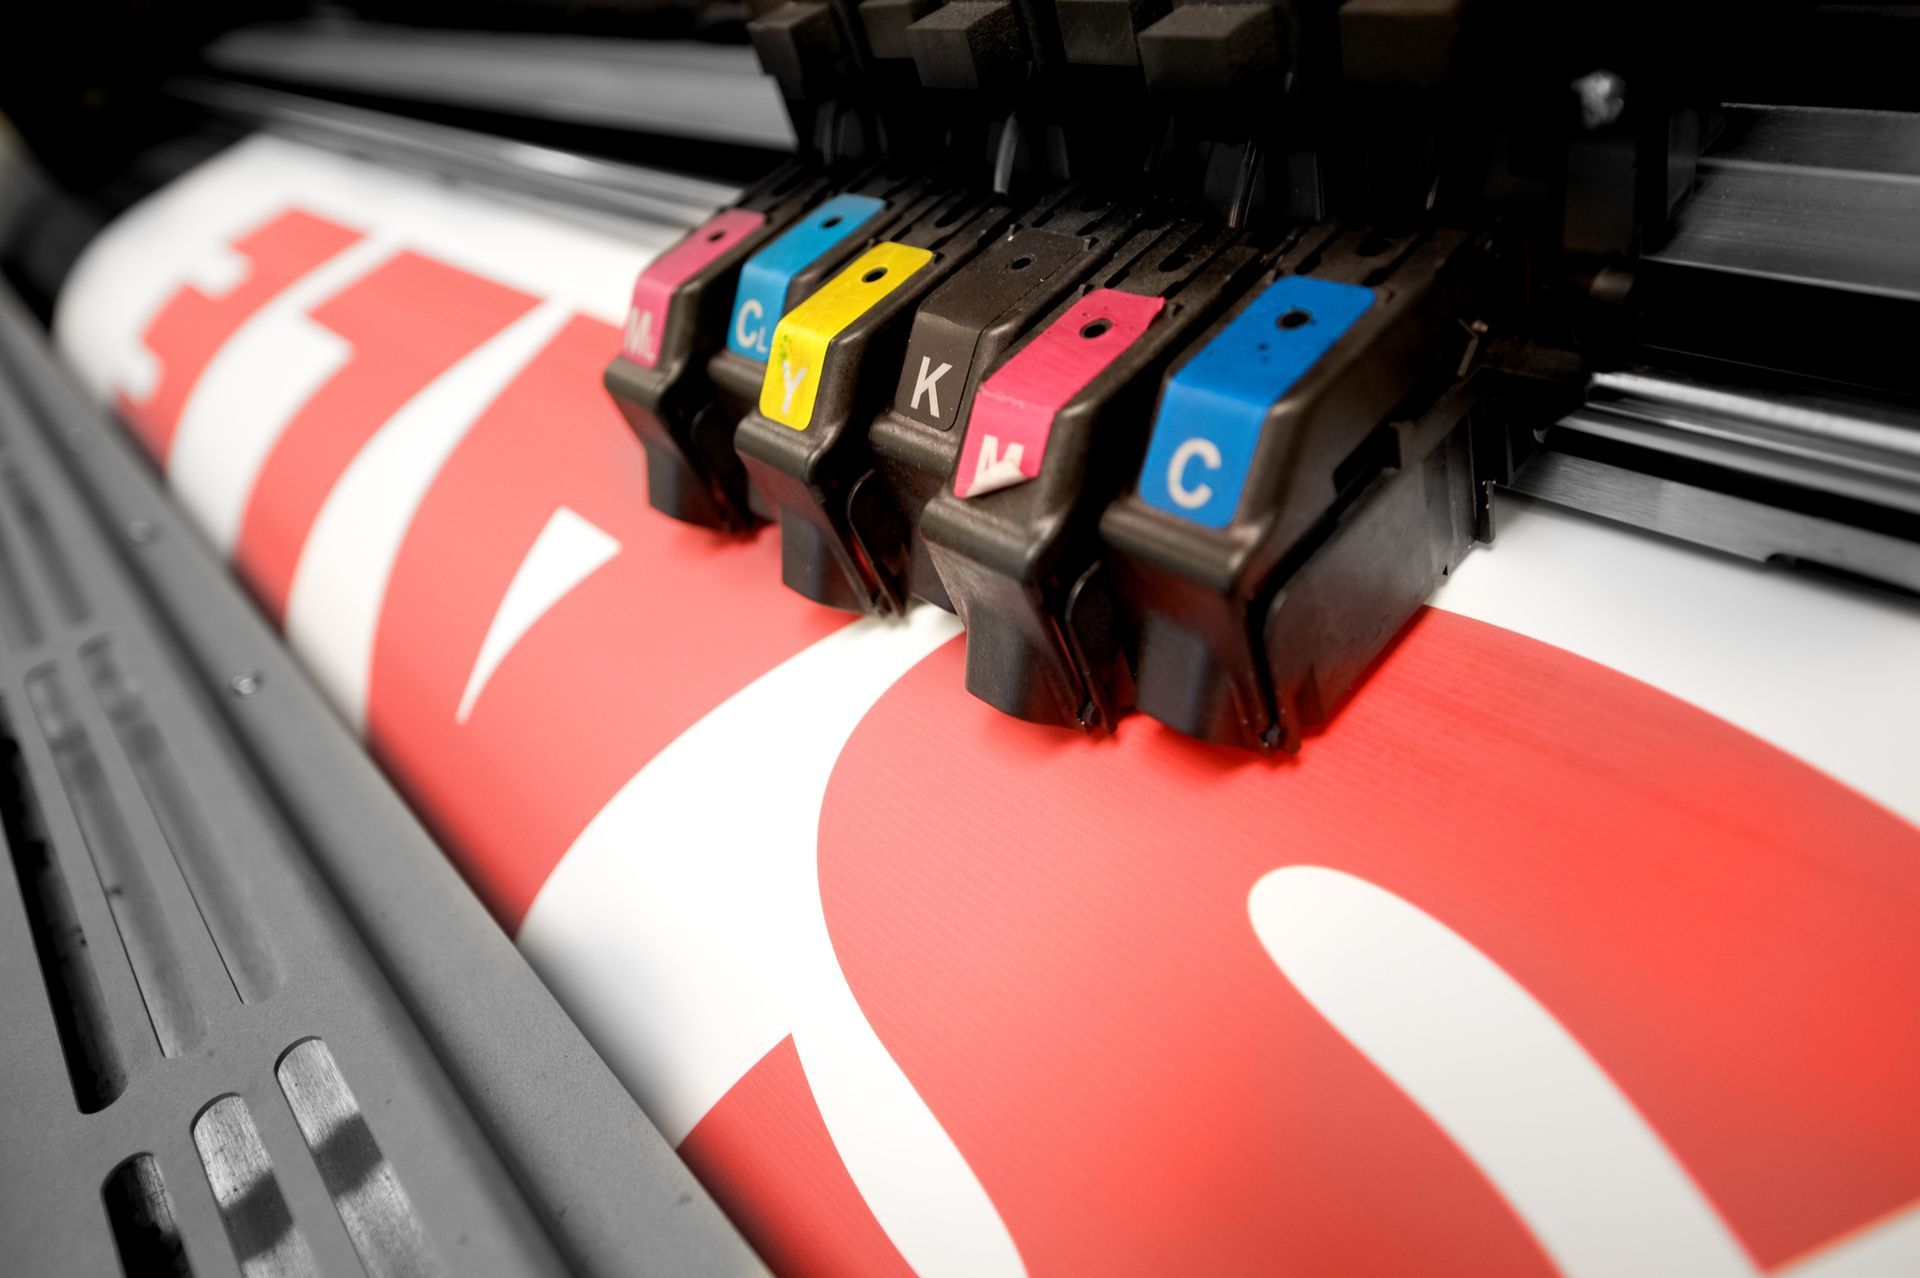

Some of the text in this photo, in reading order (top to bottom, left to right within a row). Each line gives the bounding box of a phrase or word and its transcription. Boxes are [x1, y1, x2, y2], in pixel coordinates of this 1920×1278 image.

[782, 361, 808, 415] Y
[911, 355, 953, 419] K
[1168, 438, 1222, 509] C
